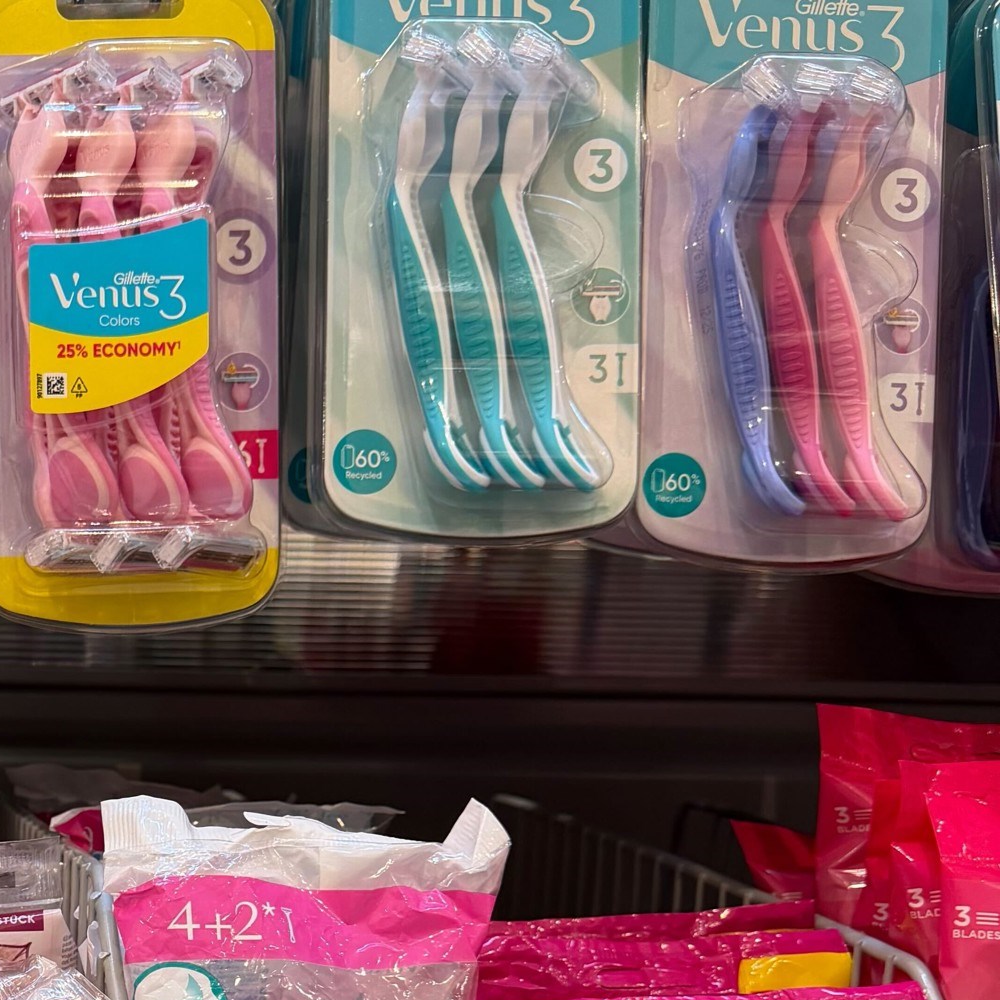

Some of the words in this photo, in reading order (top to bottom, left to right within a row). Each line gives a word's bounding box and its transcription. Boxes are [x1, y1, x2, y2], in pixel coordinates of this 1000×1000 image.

[589, 149, 614, 184] 3
[895, 178, 918, 214] 3
[228, 230, 252, 266] 3
[50, 272, 160, 310] Venus
[99, 314, 140, 328] Colors
[56, 344, 88, 359] 25%
[588, 355, 608, 384] 3
[890, 382, 908, 412] 3
[355, 450, 390, 469] 60%
[345, 471, 383, 481] Recycled
[665, 473, 701, 492] 60%
[655, 495, 693, 504] Recycled
[834, 807, 850, 824] 3
[907, 888, 925, 908] 3
[872, 903, 889, 921] 3
[954, 906, 971, 927] 3
[952, 929, 1000, 940] BLADES
